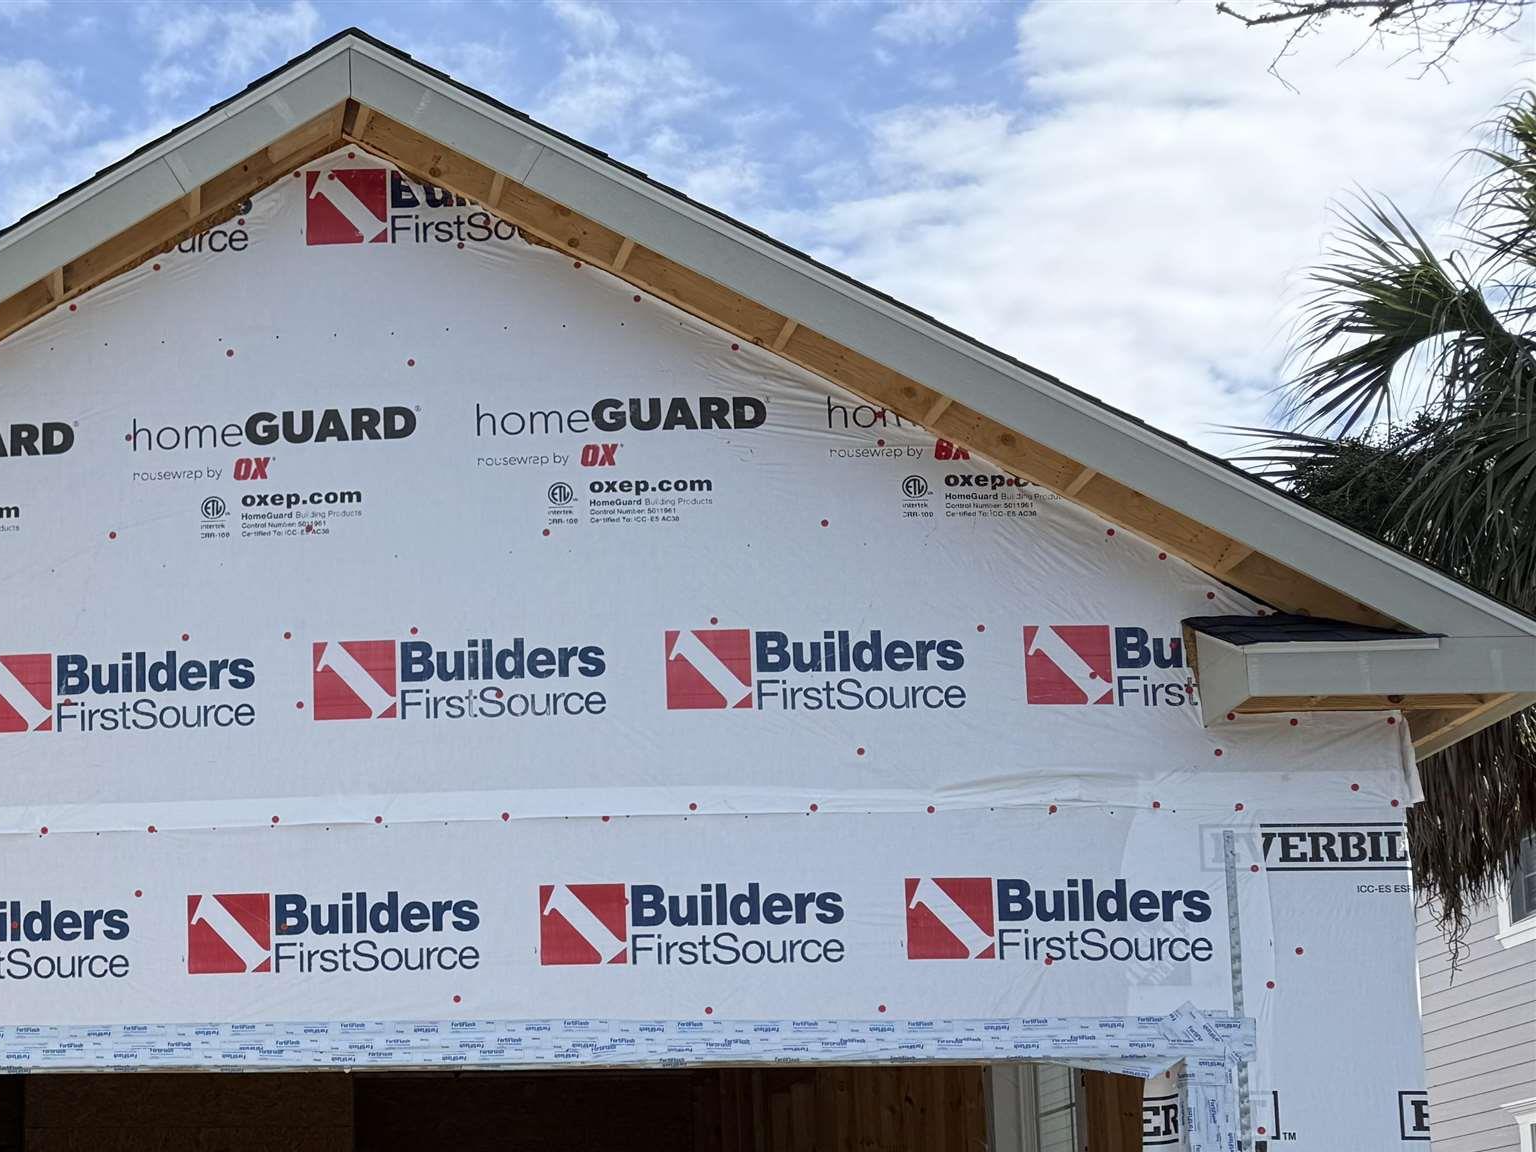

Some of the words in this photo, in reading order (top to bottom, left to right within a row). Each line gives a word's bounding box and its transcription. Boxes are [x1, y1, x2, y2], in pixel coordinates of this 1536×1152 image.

[133, 406, 416, 451] homeGUARD
[476, 396, 767, 436] homeGUARD
[207, 467, 223, 481] by
[233, 457, 269, 481] OX
[553, 452, 569, 466] by
[580, 443, 618, 467] OX
[906, 445, 923, 459] by
[241, 490, 362, 508] oxep.com
[589, 478, 712, 495] oxep.com
[589, 498, 642, 506] HomeGuard
[241, 512, 292, 520] HomeGuard
[400, 638, 605, 682] Builders
[755, 629, 964, 673] Builders
[56, 651, 256, 696] Builders
[400, 684, 606, 720] FirstSource
[757, 677, 966, 710] FirstSource
[56, 697, 256, 732] FirstSource
[274, 890, 480, 934] Builders
[631, 883, 844, 927] Builders
[997, 878, 1213, 923] Builders
[274, 939, 480, 973] FirstSource
[631, 931, 846, 965] FirstSource
[998, 928, 1213, 963] FirstSource
[1282, 1131, 1297, 1142] TM
